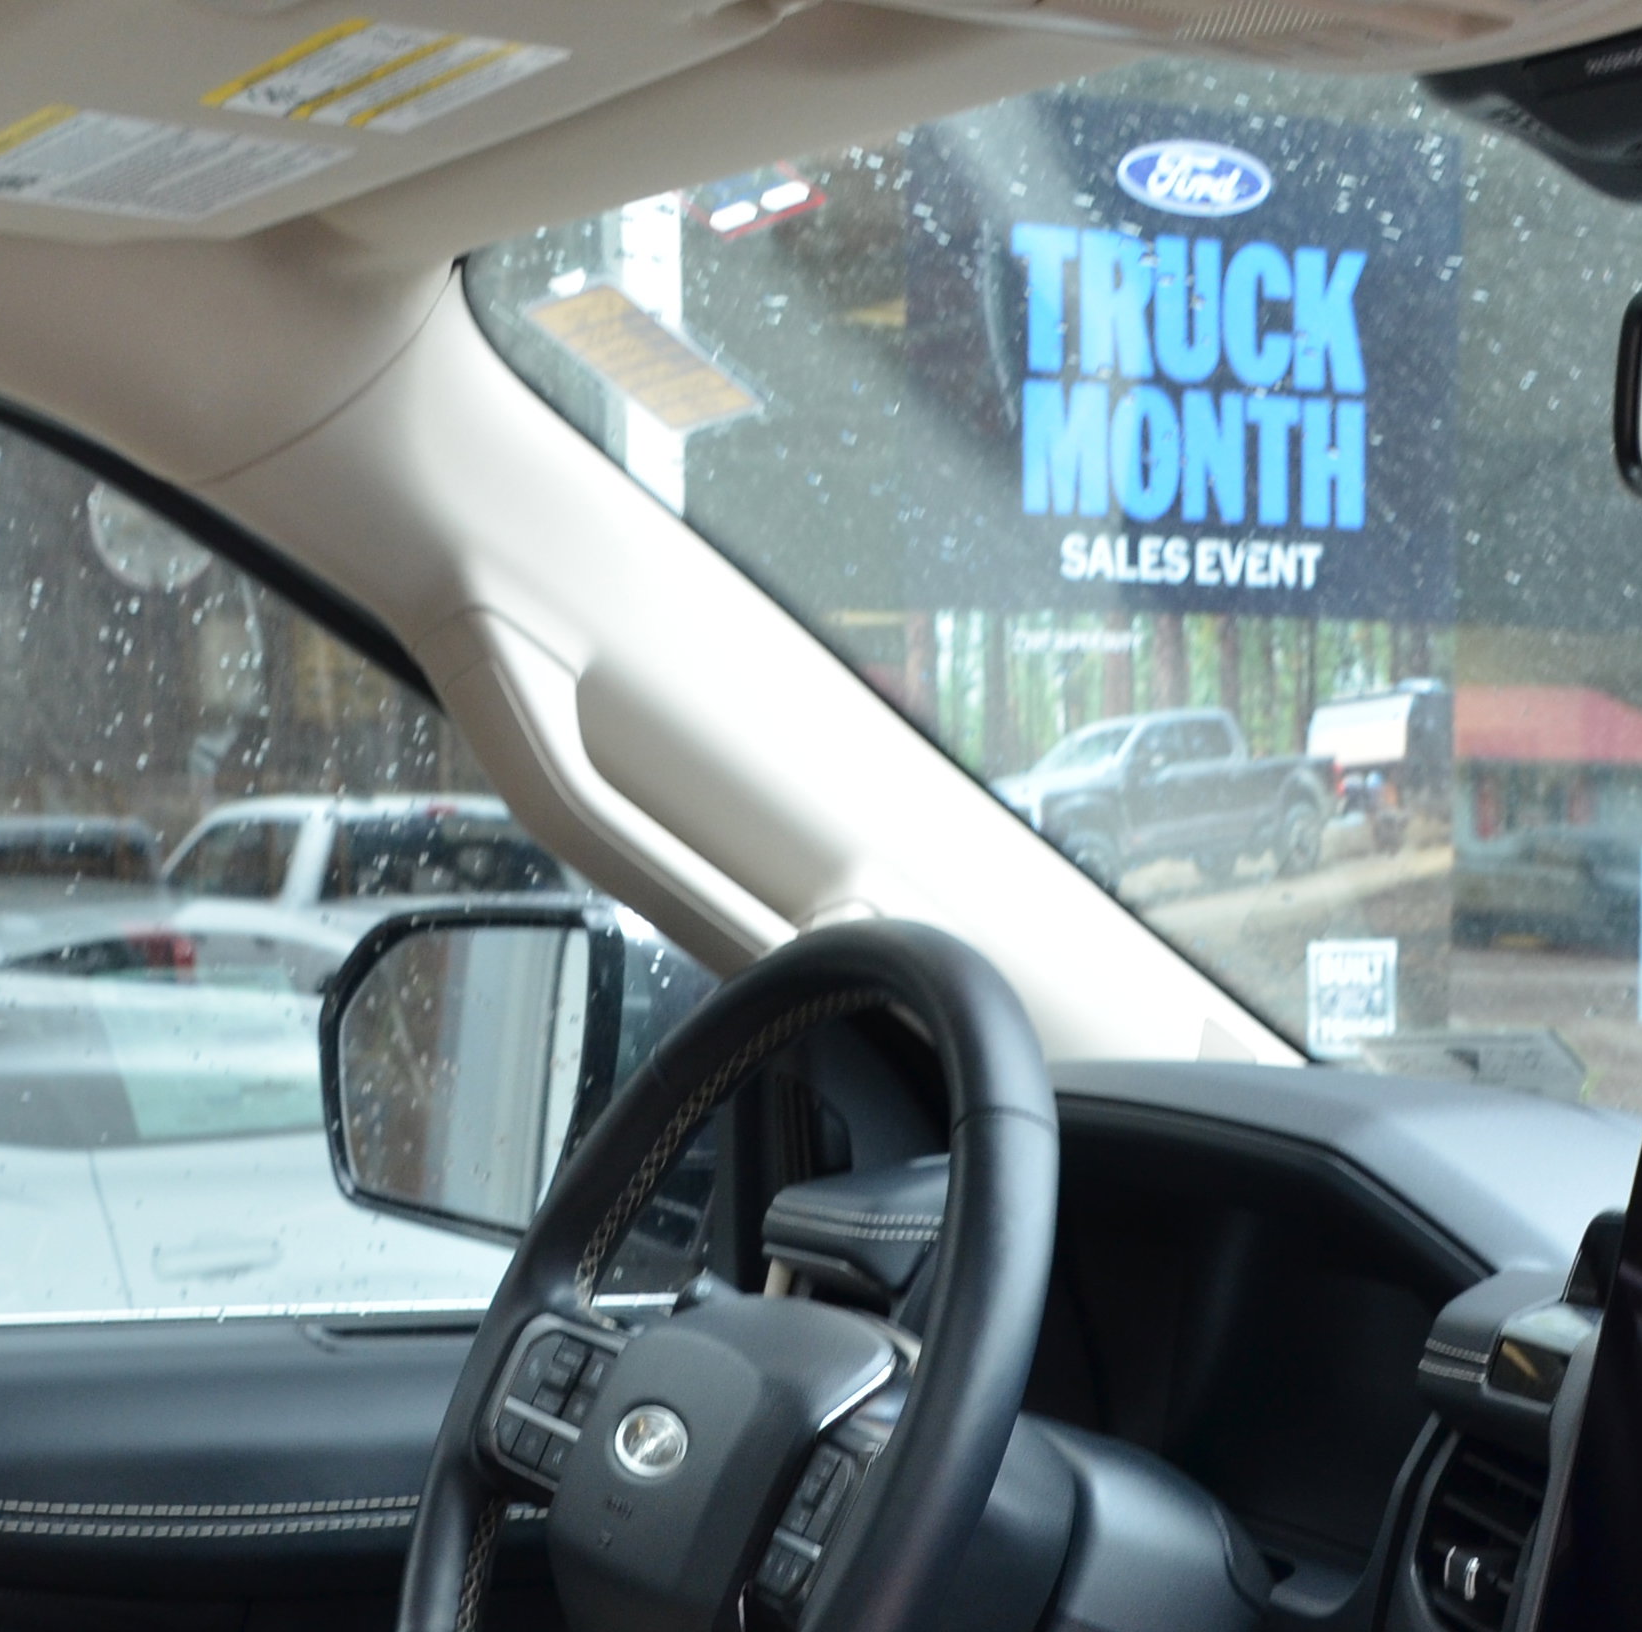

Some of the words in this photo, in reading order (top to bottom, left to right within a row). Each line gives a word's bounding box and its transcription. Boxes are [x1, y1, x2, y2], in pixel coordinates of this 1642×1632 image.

[1146, 148, 1243, 204] Ford
[1010, 222, 1368, 395] TRUCK
[1021, 378, 1367, 531] MONTH
[1059, 532, 1192, 584] SALES
[1194, 536, 1324, 590] EVENT
